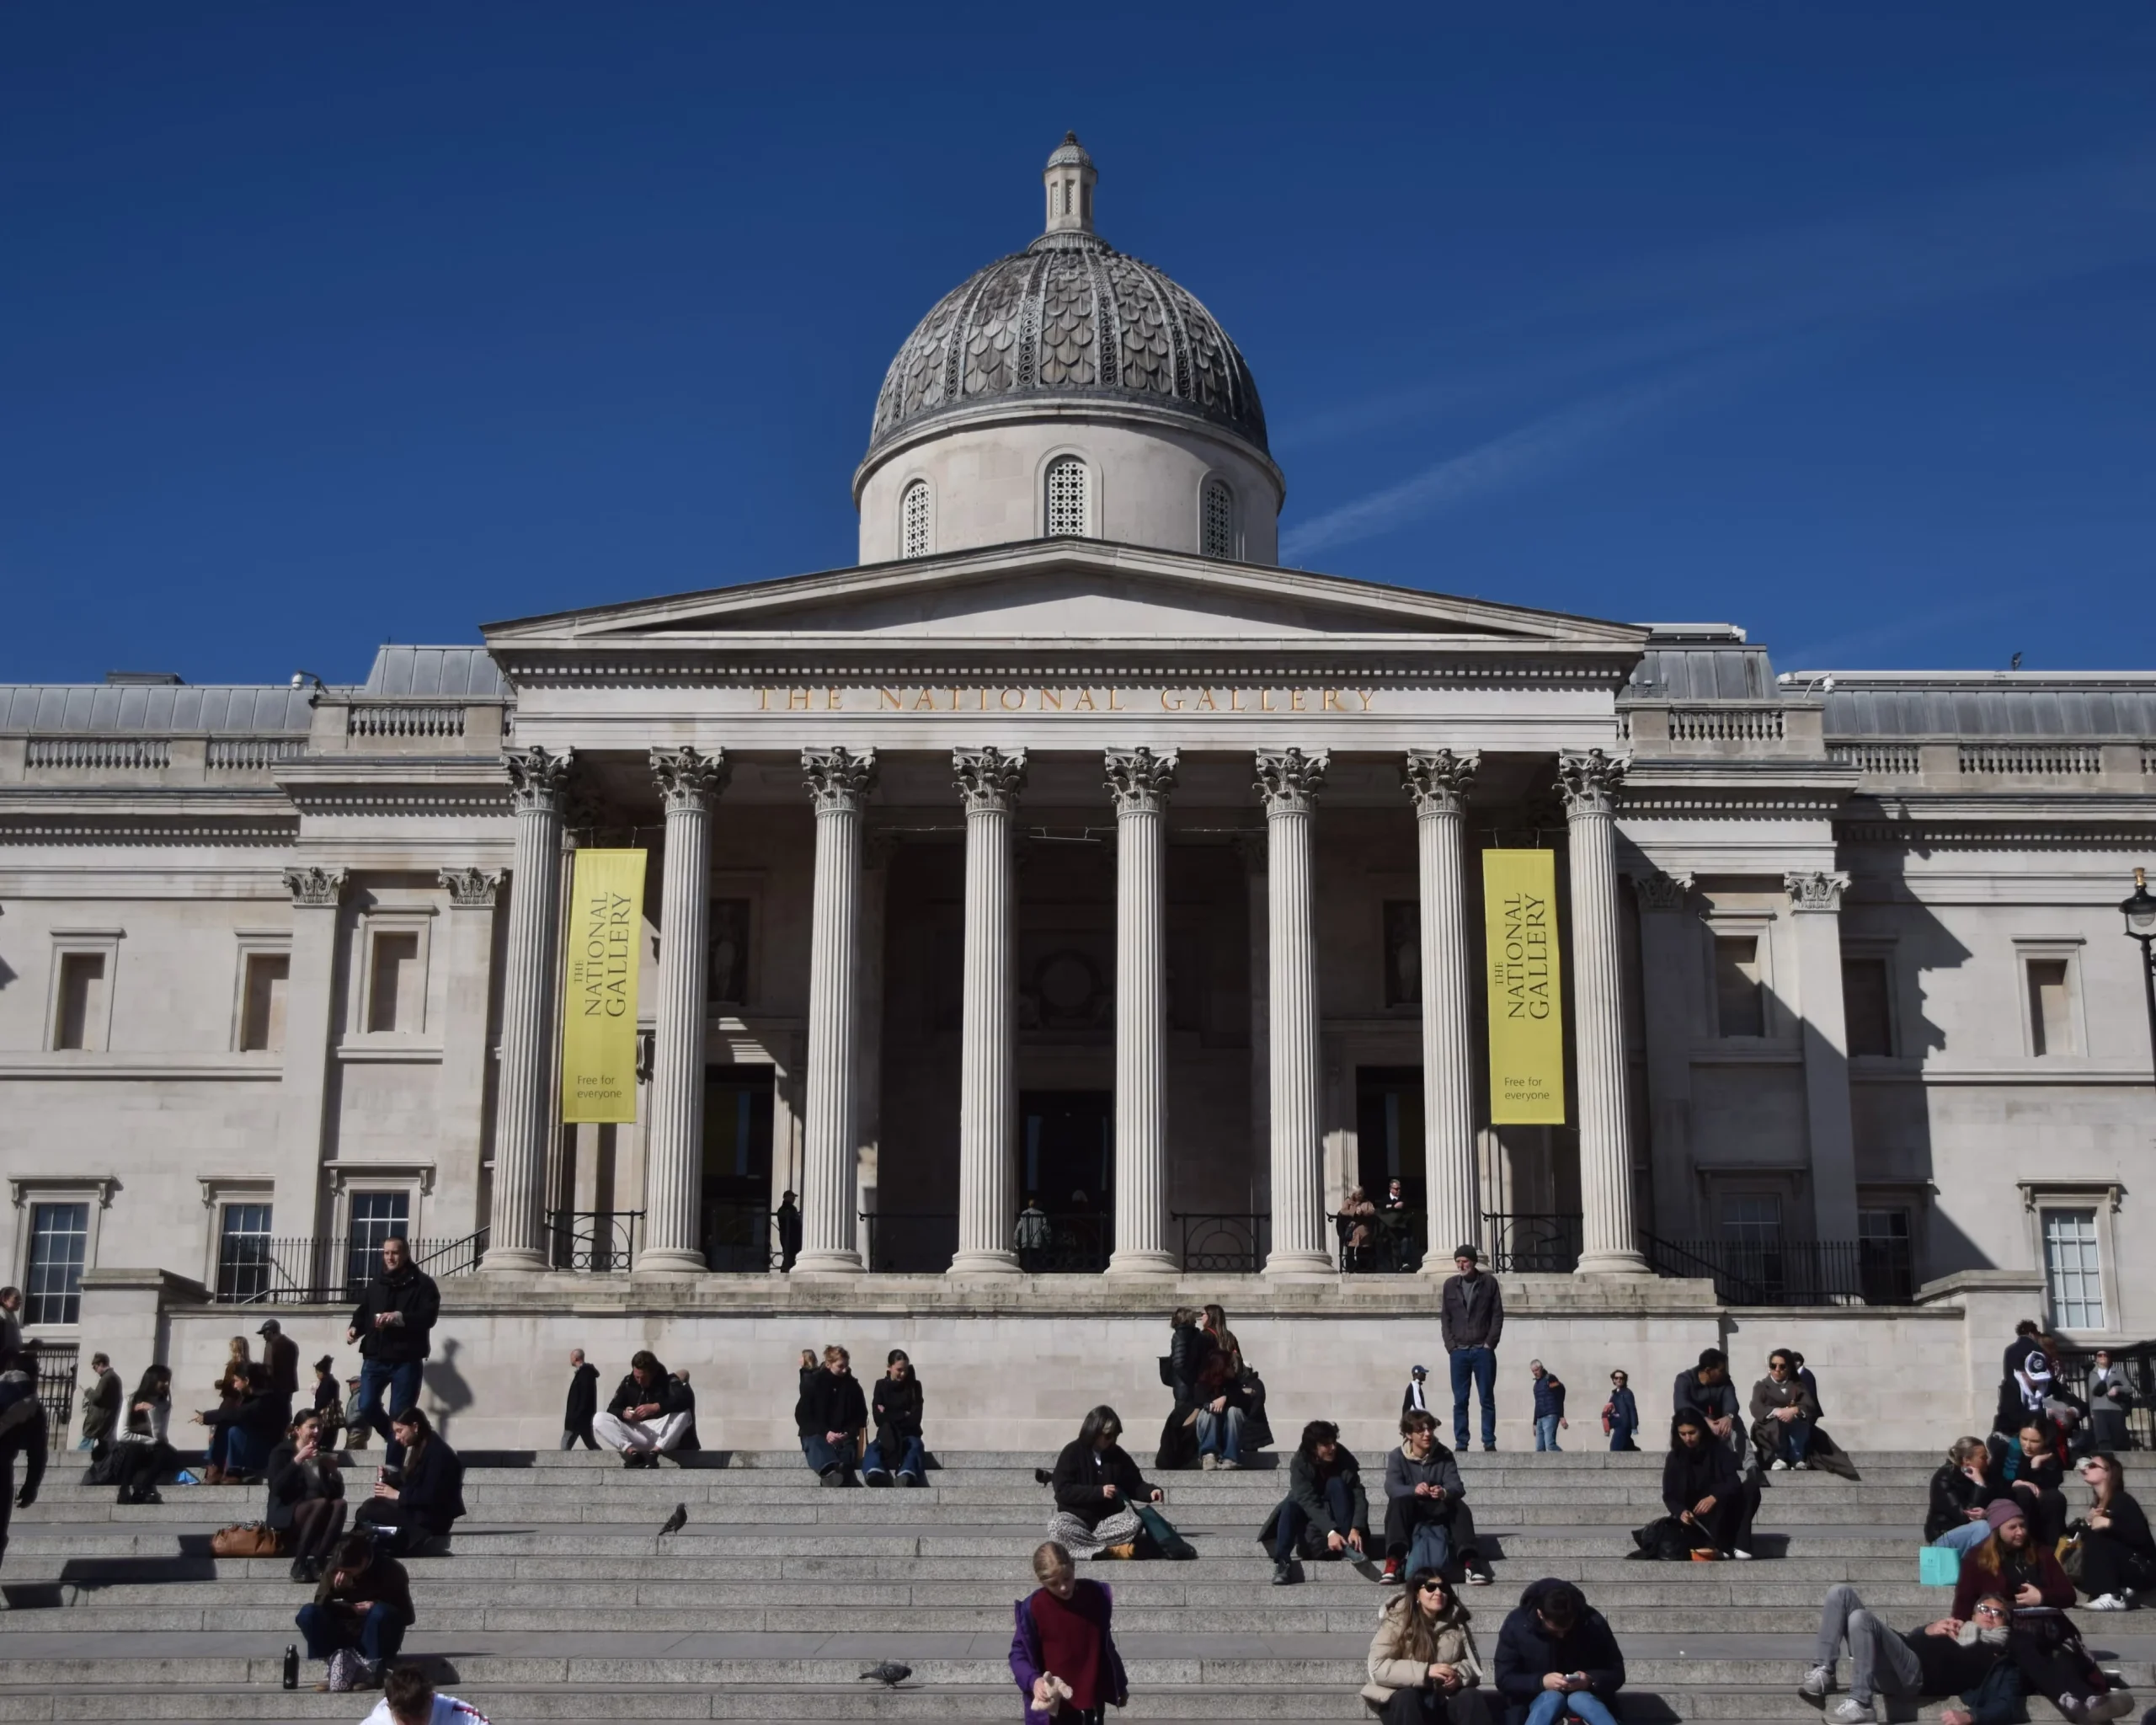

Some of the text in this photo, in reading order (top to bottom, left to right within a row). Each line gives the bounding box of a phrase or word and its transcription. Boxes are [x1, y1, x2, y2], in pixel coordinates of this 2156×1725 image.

[753, 687, 1375, 712] THE NATIONAL GALLERY
[584, 891, 608, 1017] NATIONAL
[606, 892, 632, 1017] GALLERY
[1504, 892, 1525, 1020] NATIONAL
[1525, 893, 1550, 1020] GALLERY
[574, 959, 584, 984] THE
[1494, 961, 1503, 987] THE
[577, 1075, 615, 1085] Free for
[1504, 1076, 1543, 1087] Free for
[577, 1090, 622, 1099] everyone
[1504, 1092, 1550, 1102] everyone
